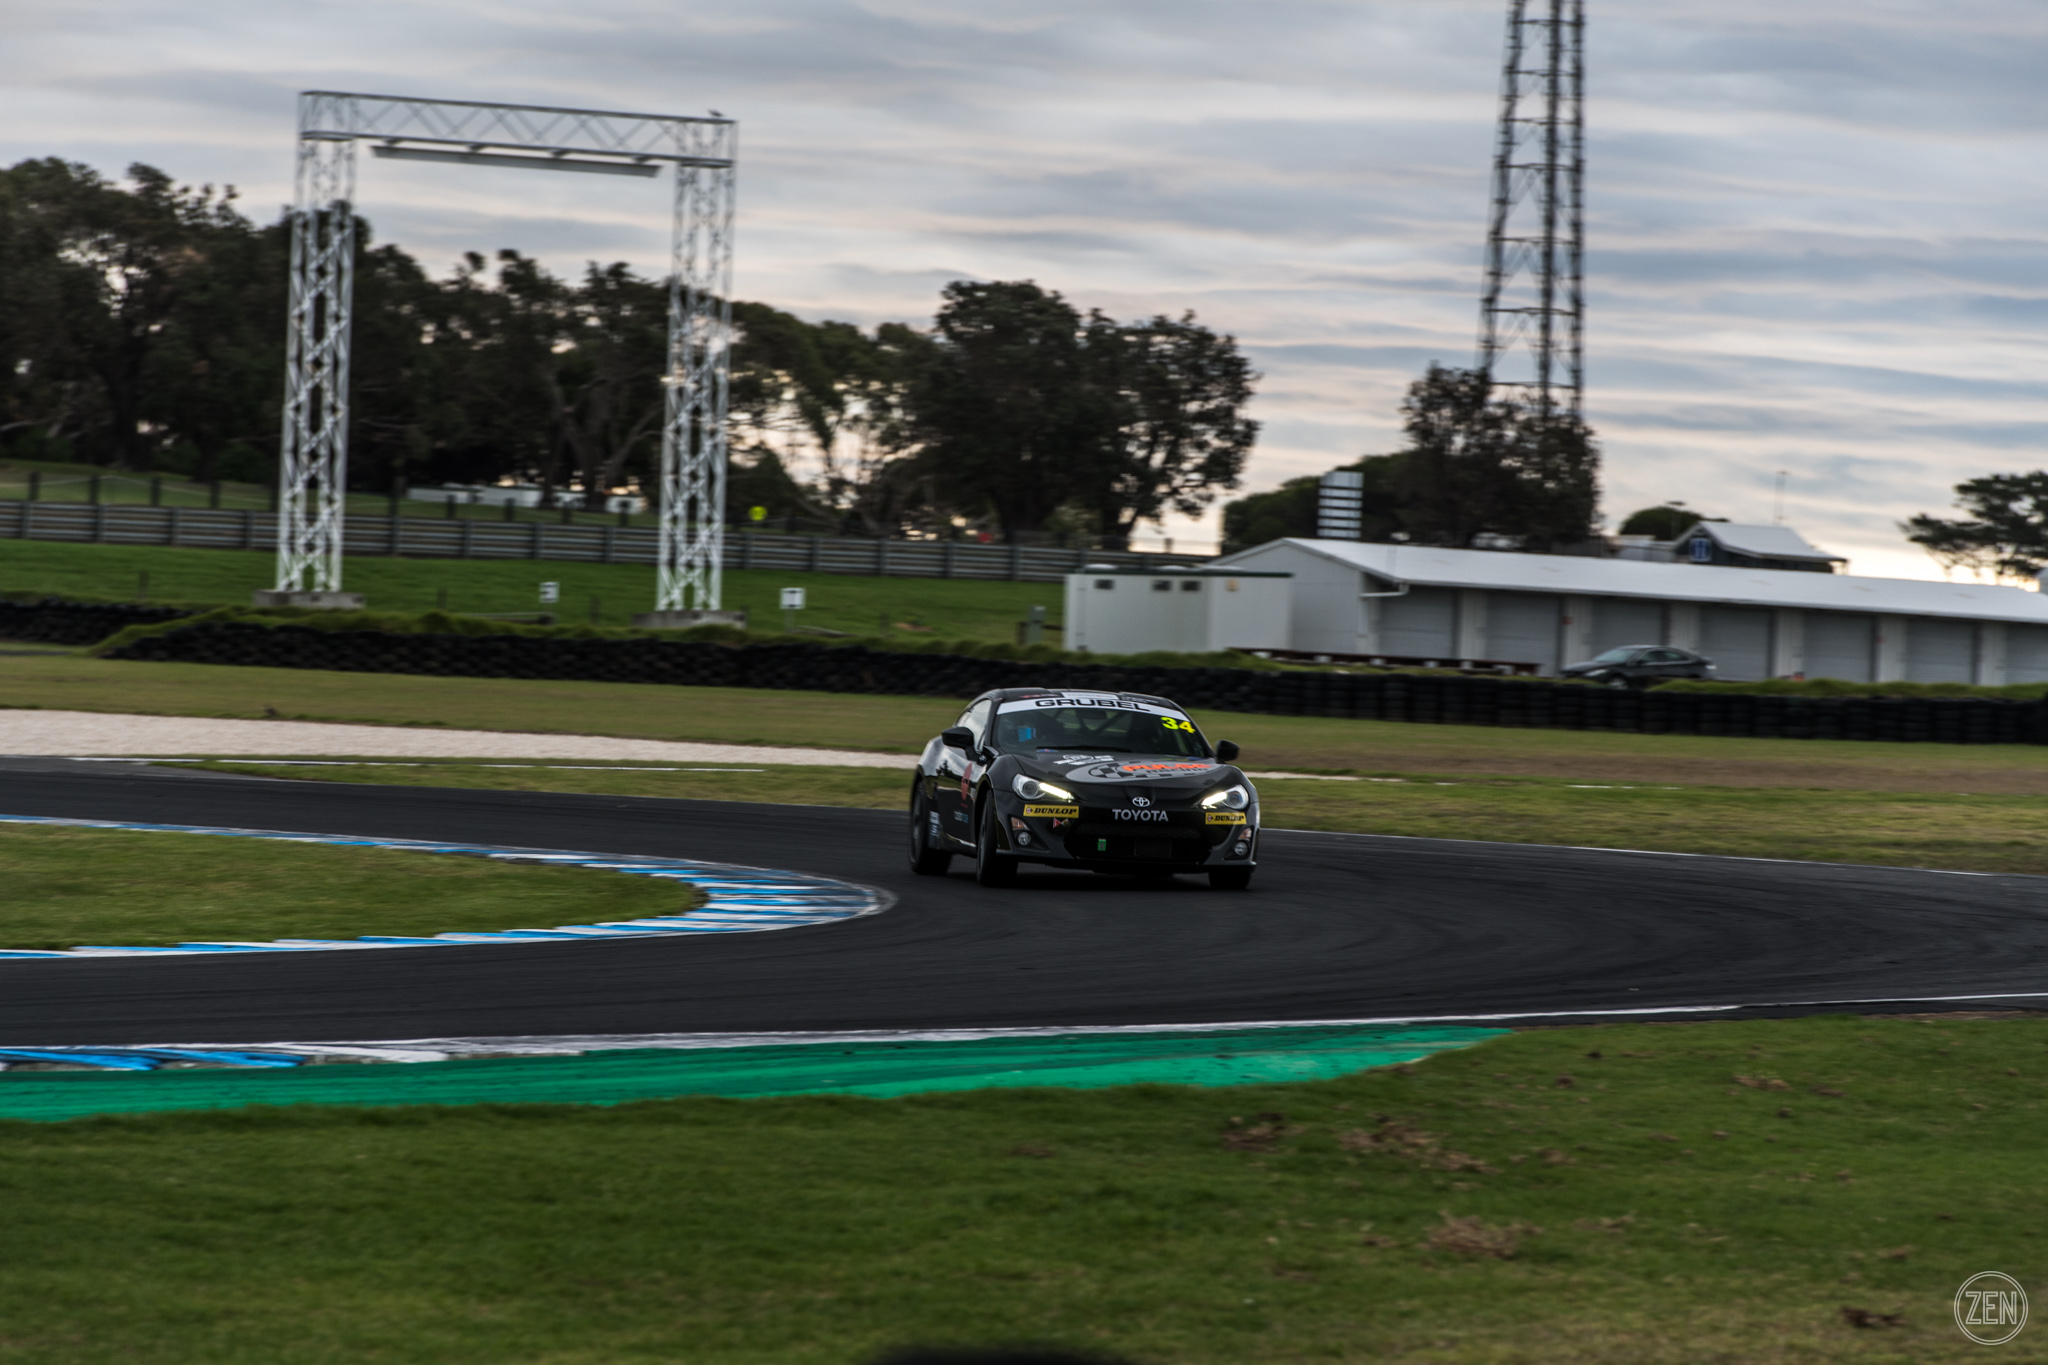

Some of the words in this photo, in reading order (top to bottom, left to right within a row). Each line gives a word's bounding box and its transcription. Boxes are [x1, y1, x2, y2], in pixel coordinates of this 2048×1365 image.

[1035, 698, 1151, 712] GRUBEL
[1161, 716, 1196, 734] 34
[1033, 807, 1077, 816] DUNLOP
[1112, 809, 1169, 822] TOYOTA
